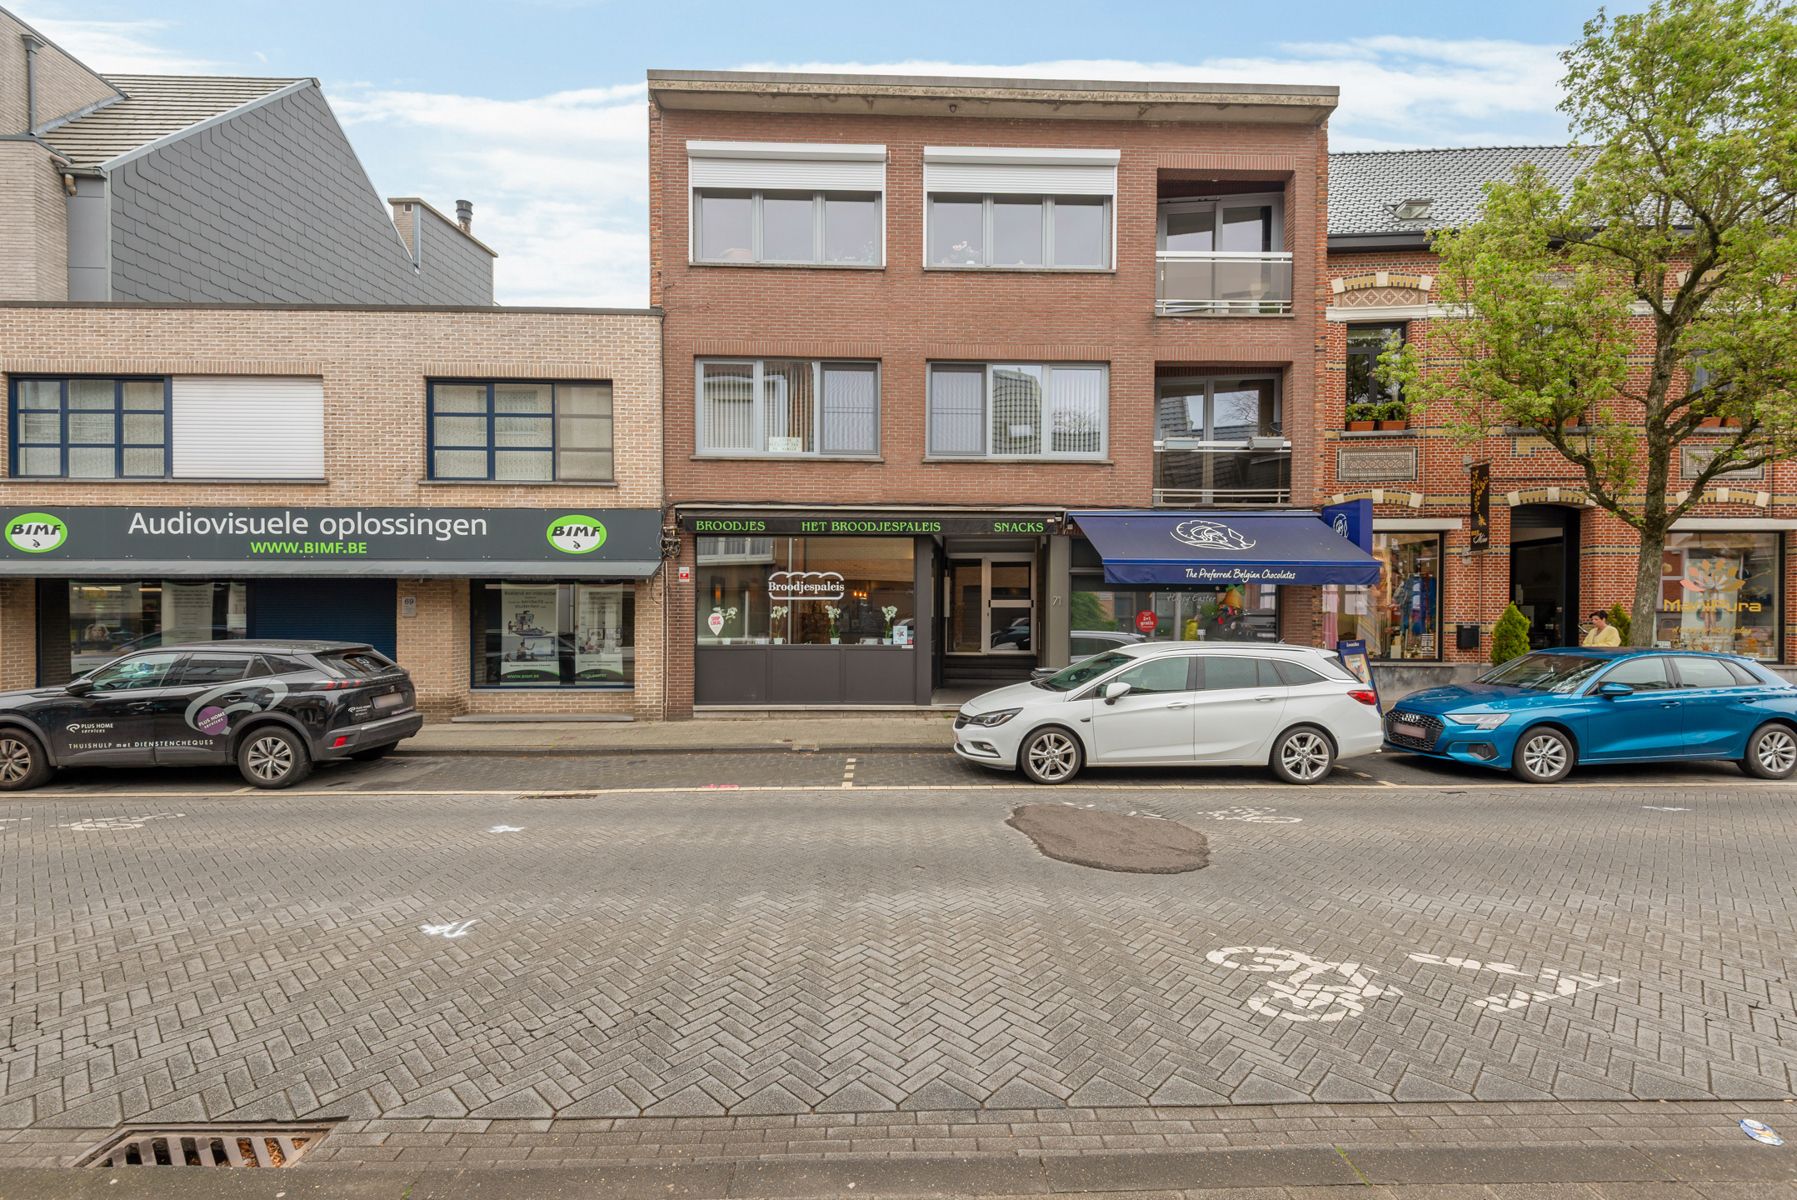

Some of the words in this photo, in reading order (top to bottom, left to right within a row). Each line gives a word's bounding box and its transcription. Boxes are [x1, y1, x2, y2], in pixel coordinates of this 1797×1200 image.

[10, 524, 62, 535] BIMF
[128, 511, 309, 534] Audiovisuele
[319, 511, 487, 541] oplossingen
[696, 520, 766, 531] BROODJES
[801, 521, 827, 531] HET
[831, 521, 941, 532] BROODJESPALEIS
[994, 522, 1044, 532] SNACKS
[551, 526, 601, 537] BIMF
[250, 541, 367, 554] WWW.BIMF.BE
[1185, 568, 1197, 579] The
[1198, 568, 1232, 581] Preferred
[1233, 568, 1260, 583] Belgian
[1261, 569, 1296, 580] Chocolates
[768, 581, 845, 594] Broodjespaleis
[134, 739, 214, 747] DIENSTENCHEQUES
